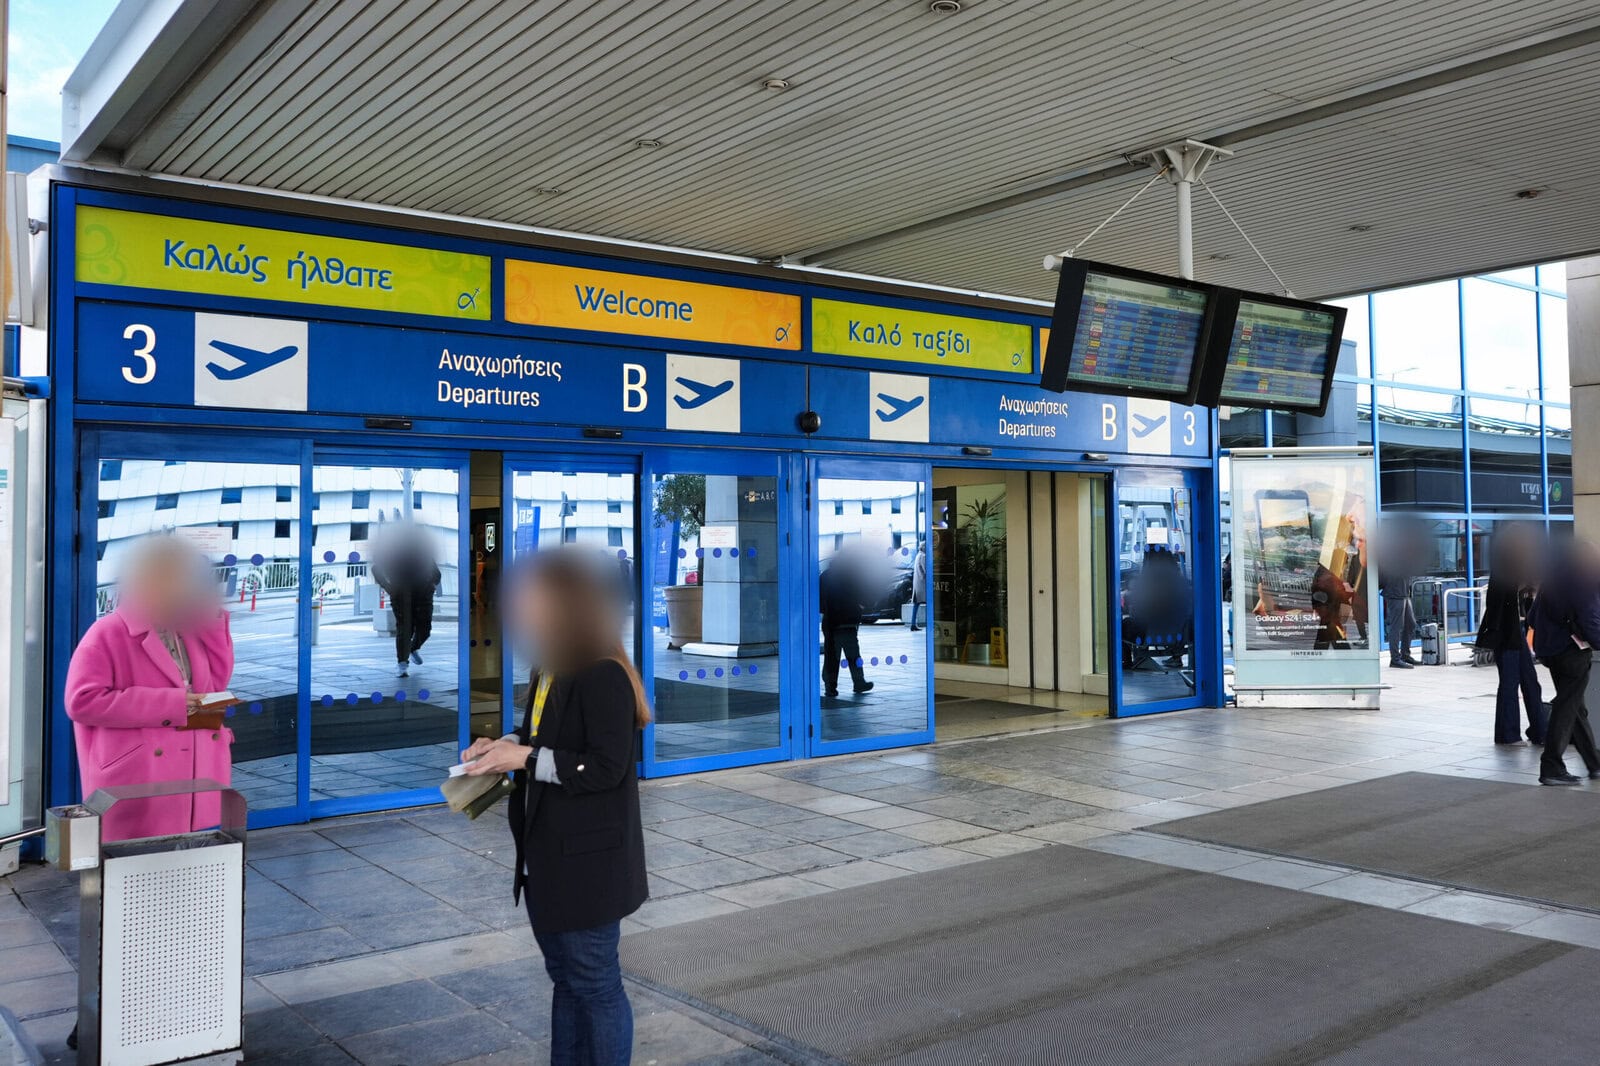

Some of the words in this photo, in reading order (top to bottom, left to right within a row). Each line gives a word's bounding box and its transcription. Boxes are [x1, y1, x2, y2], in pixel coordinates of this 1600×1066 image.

[164, 239, 269, 283] Καλώς
[287, 251, 393, 290] ήλθατε
[574, 284, 693, 322] Welcome
[121, 323, 157, 385] 3
[849, 320, 902, 347] Καλό
[912, 329, 970, 358] ταξίδι
[438, 348, 563, 382] Αναχωρήσεις
[437, 380, 541, 408] Departures
[623, 363, 649, 413] B
[999, 394, 1068, 418] Αναχωρήσεις
[999, 418, 1056, 439] Departures
[1102, 403, 1118, 441] B
[1183, 410, 1196, 446] 3
[1255, 615, 1284, 623] Galaxy
